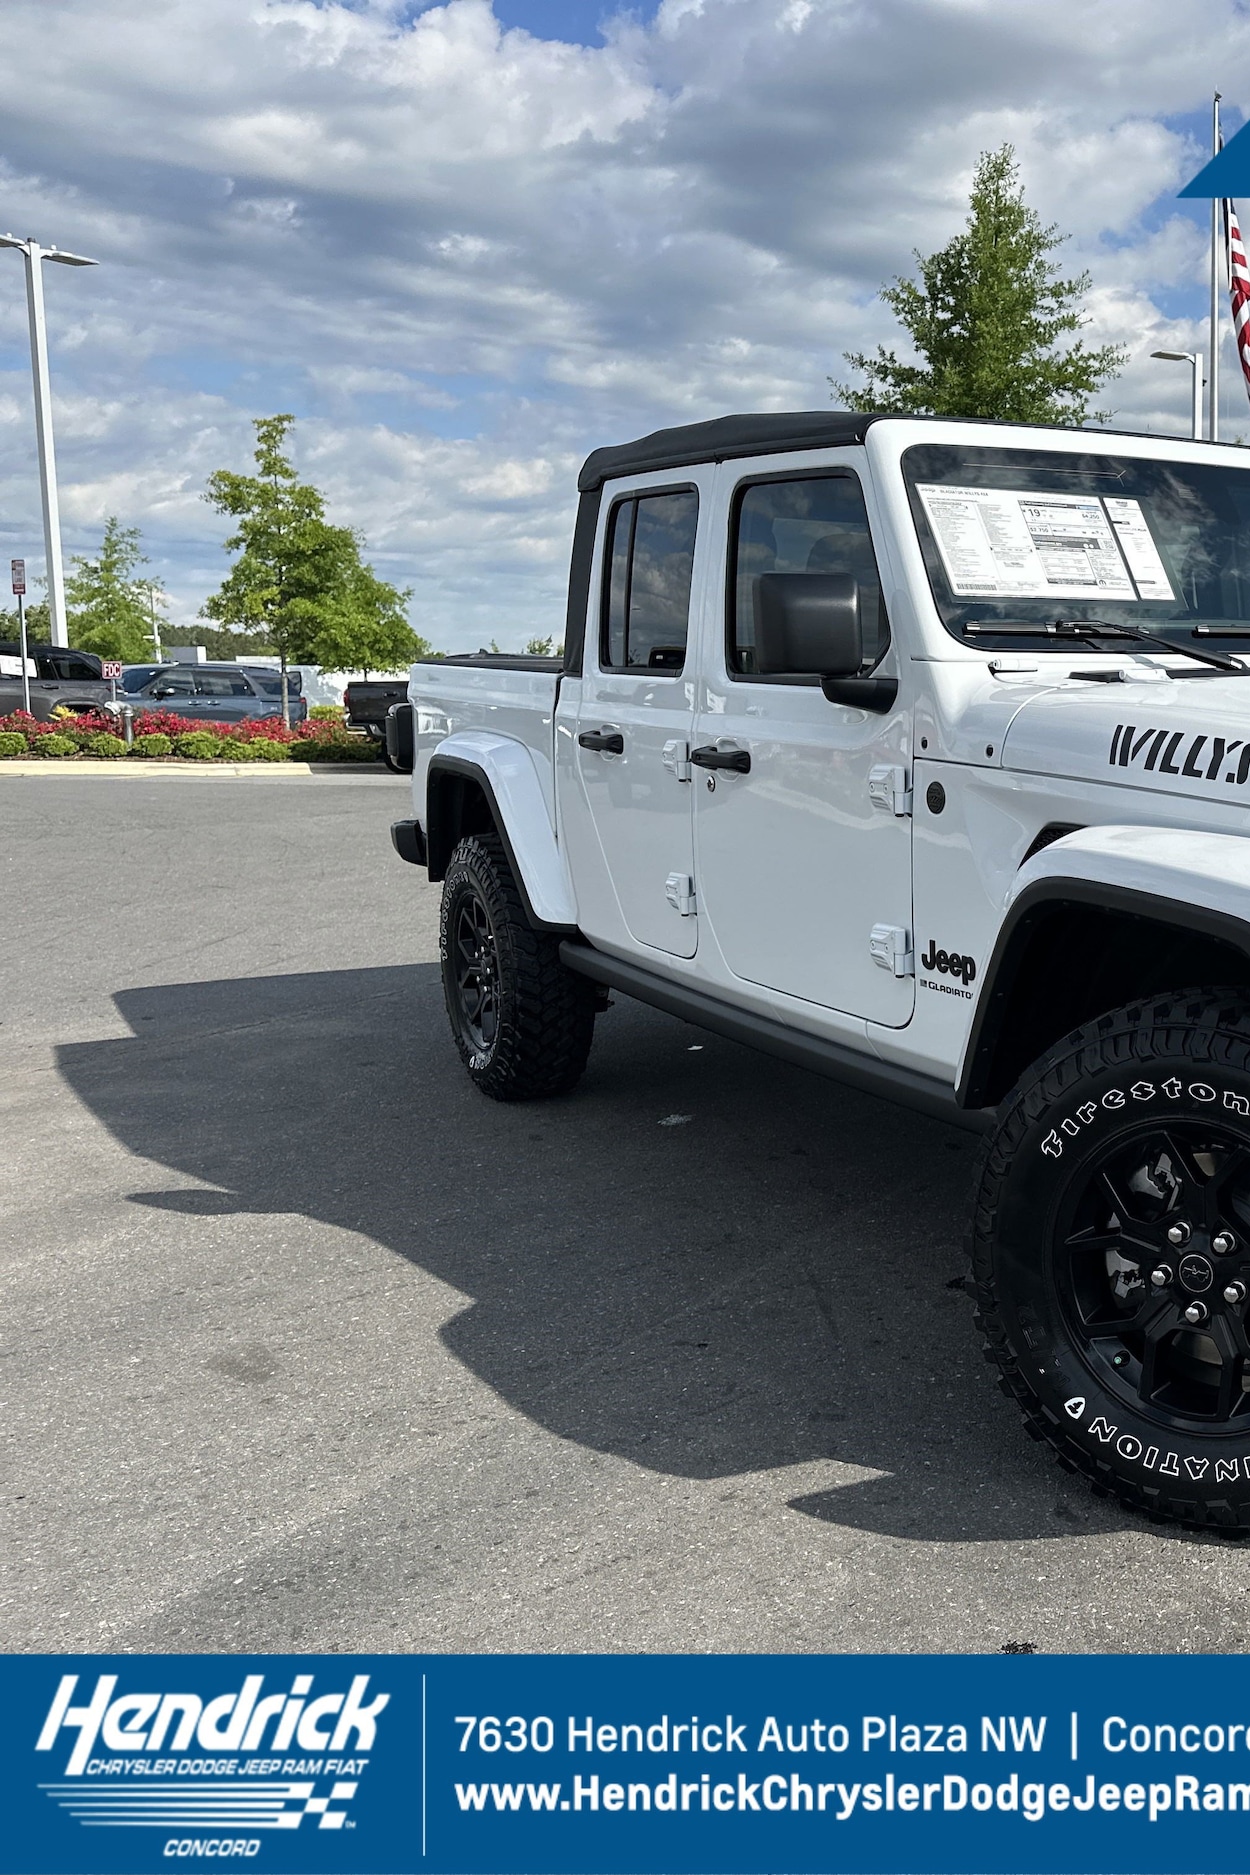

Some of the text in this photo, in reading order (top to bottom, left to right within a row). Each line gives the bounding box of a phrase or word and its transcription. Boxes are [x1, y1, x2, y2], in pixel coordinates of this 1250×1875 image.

[1028, 508, 1041, 517] 19
[103, 663, 120, 677] FDC
[921, 939, 977, 986] Jeep
[928, 981, 974, 1000] GLADIATO
